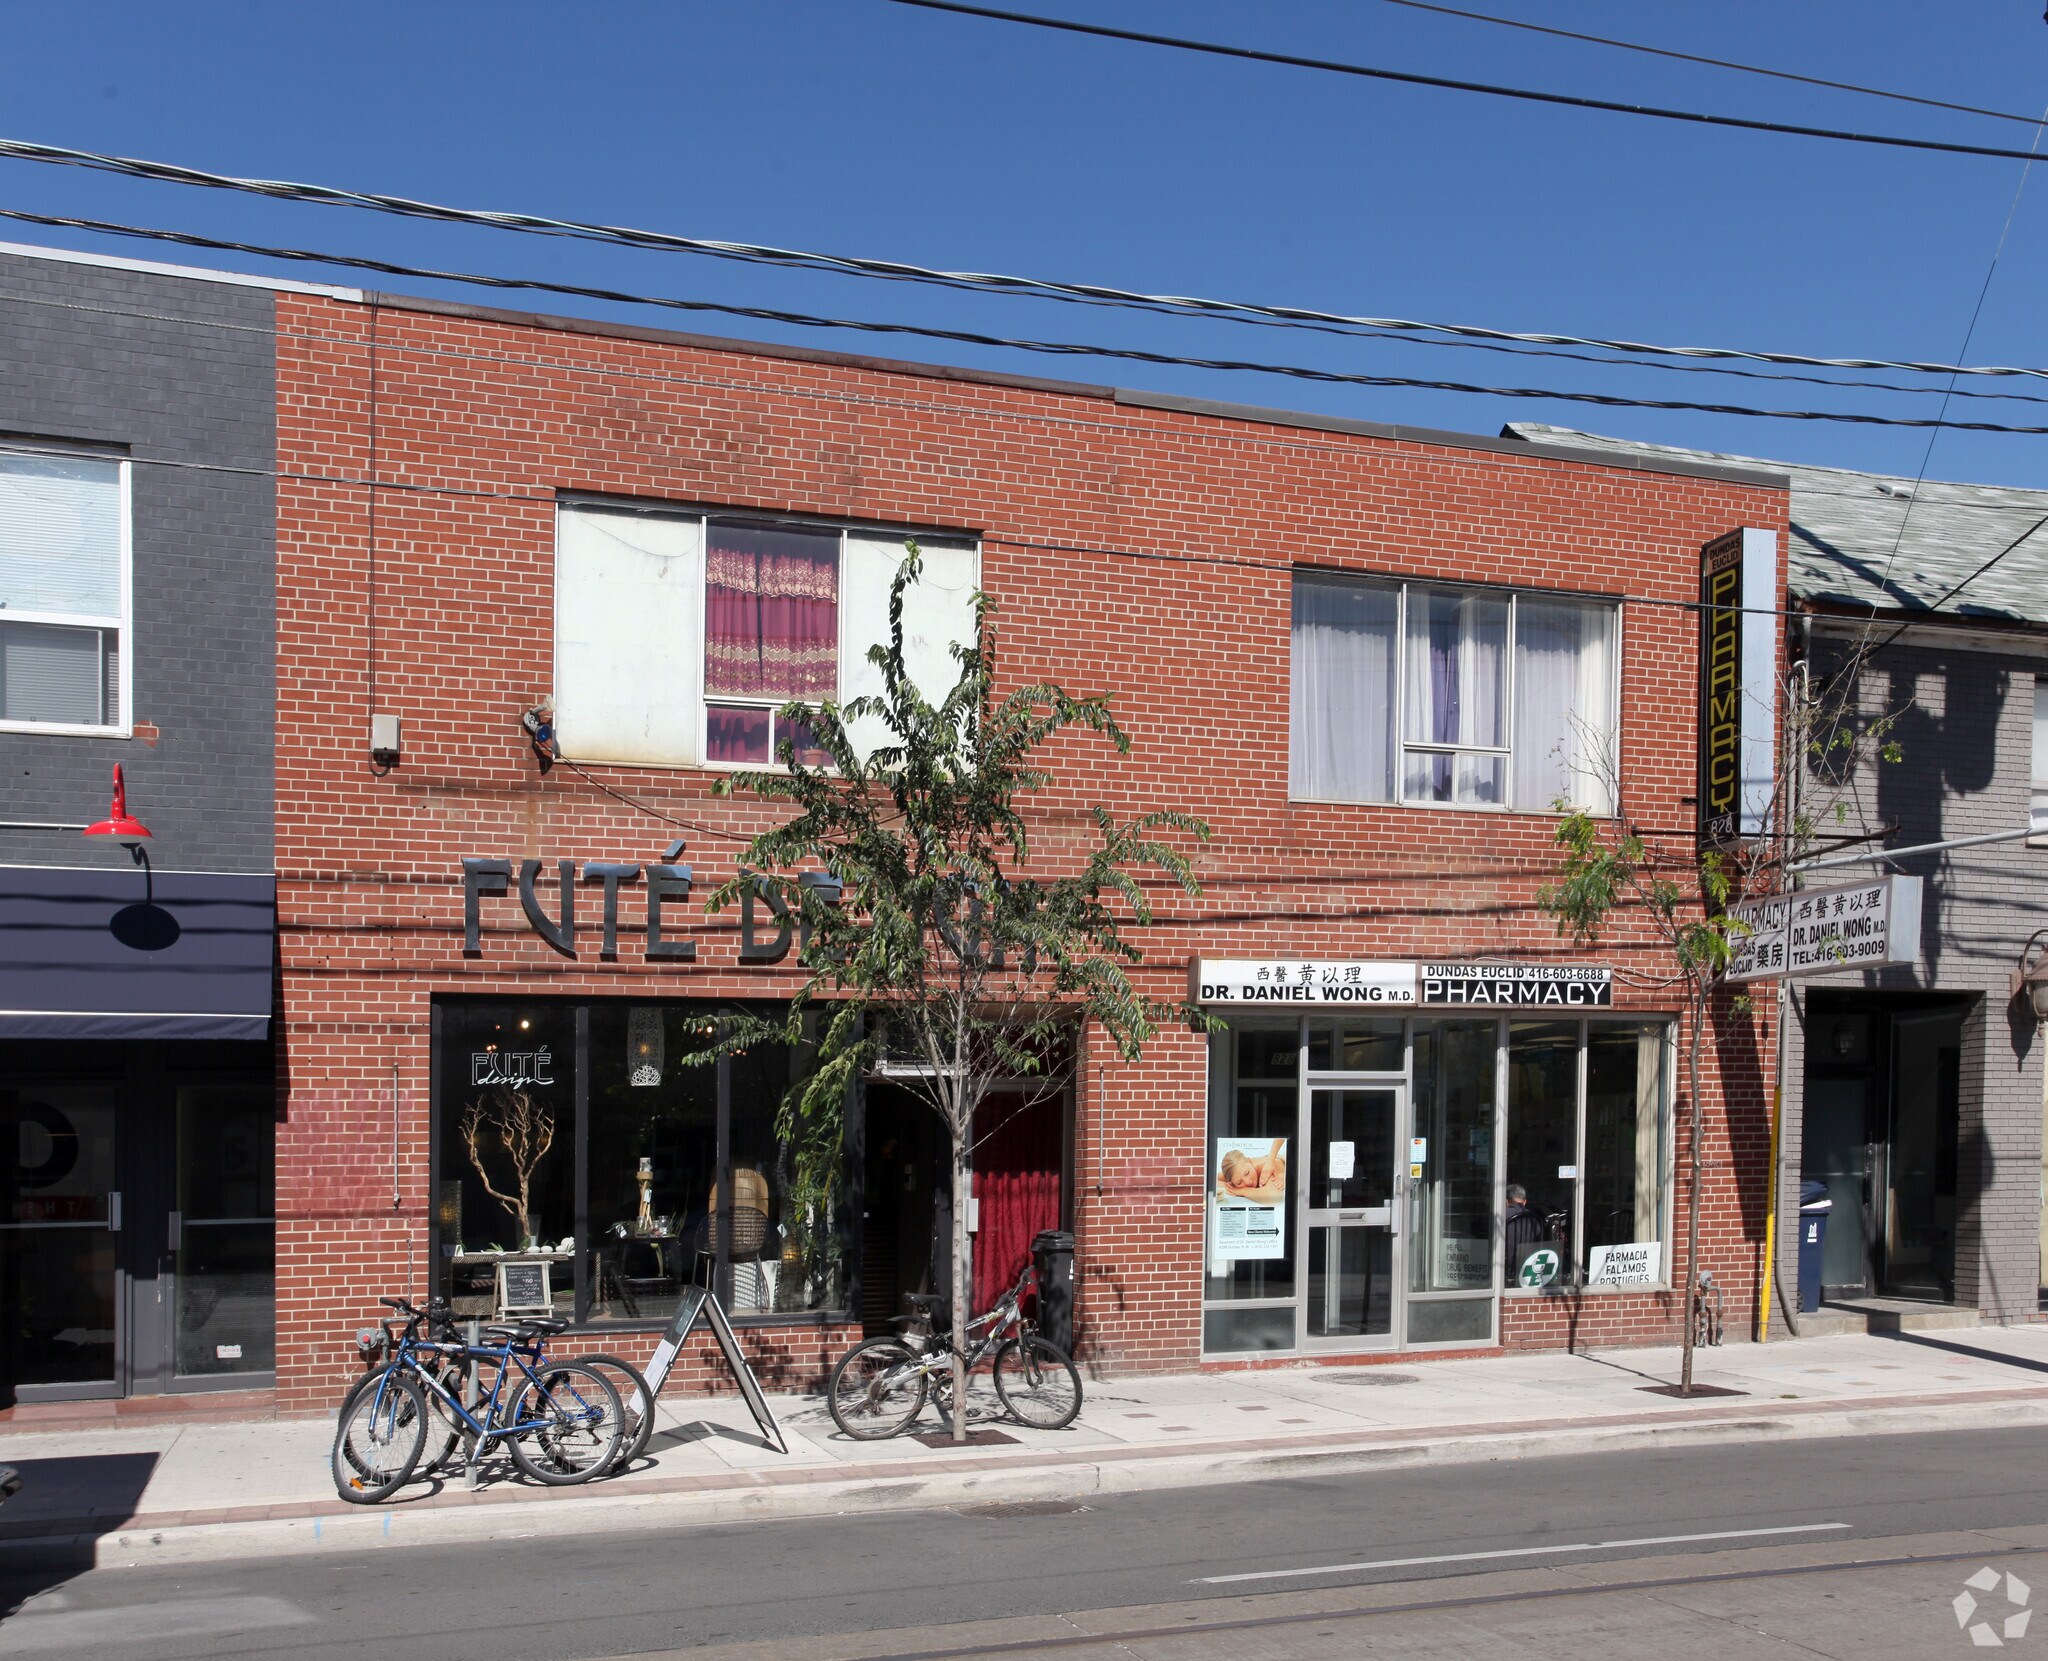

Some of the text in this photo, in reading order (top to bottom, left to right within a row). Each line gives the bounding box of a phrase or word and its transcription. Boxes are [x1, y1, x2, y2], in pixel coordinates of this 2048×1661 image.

[1710, 537, 1740, 560] DUNDAS
[1712, 550, 1738, 570] EUCLID
[1710, 568, 1736, 813] PHARMACY
[461, 839, 697, 962] FUTÉ
[1793, 927, 1807, 946] DR.
[1843, 916, 1871, 938] WONG
[1873, 920, 1887, 934] M.D.
[1757, 942, 1783, 969] 藥房
[1427, 966, 1604, 980] DUNDAS EUCLID 416-603-6688
[1729, 959, 1752, 975] EUCLID
[1201, 985, 1414, 1001] DR. DANIEL WONG M.D.
[1423, 979, 1606, 1005] PHARMACY
[471, 1044, 553, 1086] FUTÉ
[477, 1069, 555, 1090] design
[1605, 1250, 1648, 1263] FARMACIA
[1447, 1263, 1462, 1272] DRUG
[1605, 1262, 1647, 1275] FALAMOS
